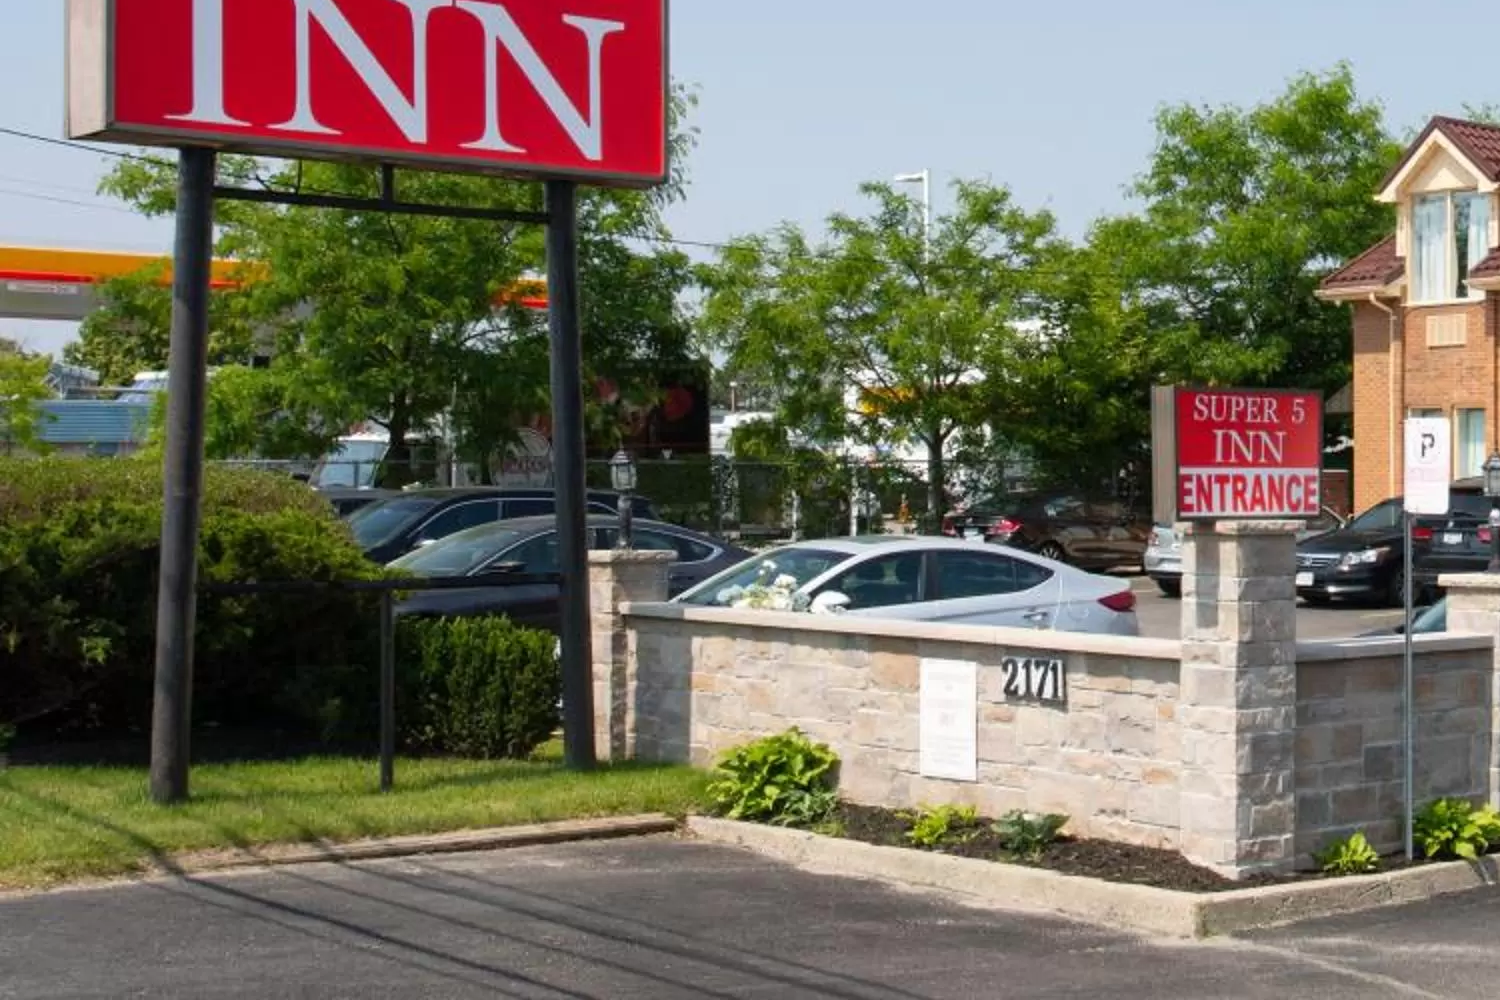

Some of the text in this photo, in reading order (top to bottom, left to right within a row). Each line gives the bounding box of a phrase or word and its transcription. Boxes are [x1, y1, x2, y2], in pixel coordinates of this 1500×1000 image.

[1193, 393, 1305, 425] SUPER 5
[1212, 428, 1288, 465] INN
[1179, 473, 1318, 514] ENTRANCE
[1001, 656, 1060, 700] 2171
